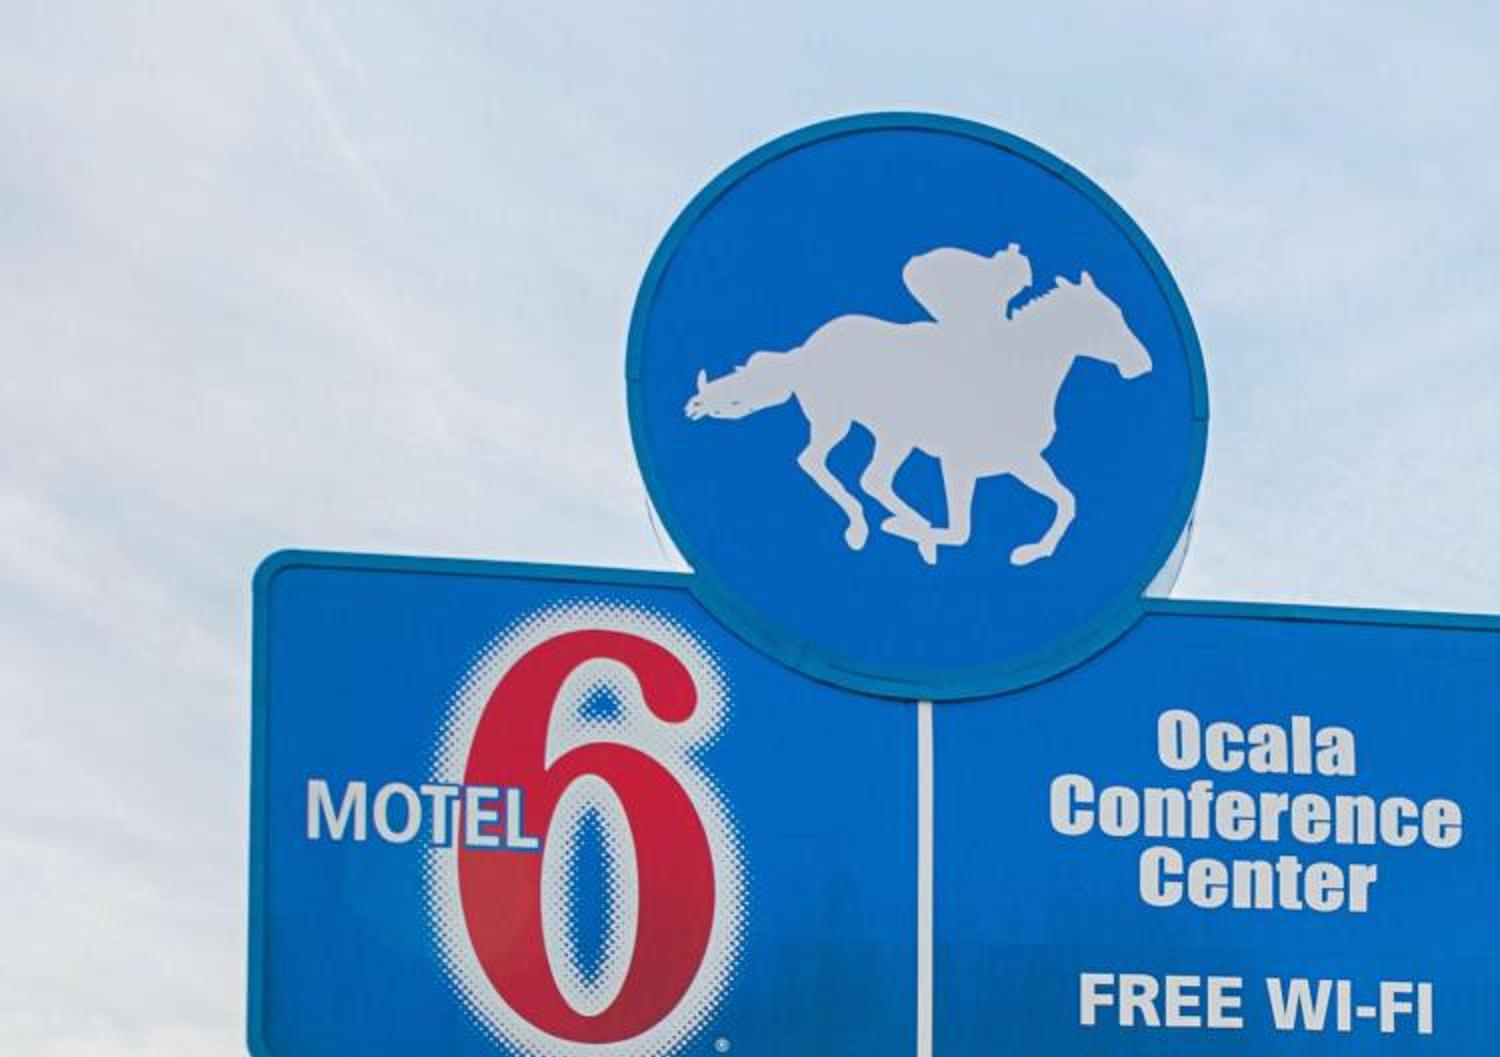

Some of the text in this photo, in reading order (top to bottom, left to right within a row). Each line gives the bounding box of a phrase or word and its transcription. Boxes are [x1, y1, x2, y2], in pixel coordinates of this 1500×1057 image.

[1157, 709, 1356, 776] Ocala
[304, 628, 717, 1045] MOTEL 6
[1050, 773, 1462, 848] Conference
[1139, 845, 1377, 913] Center
[1080, 972, 1433, 1034] FREE WI-FI
